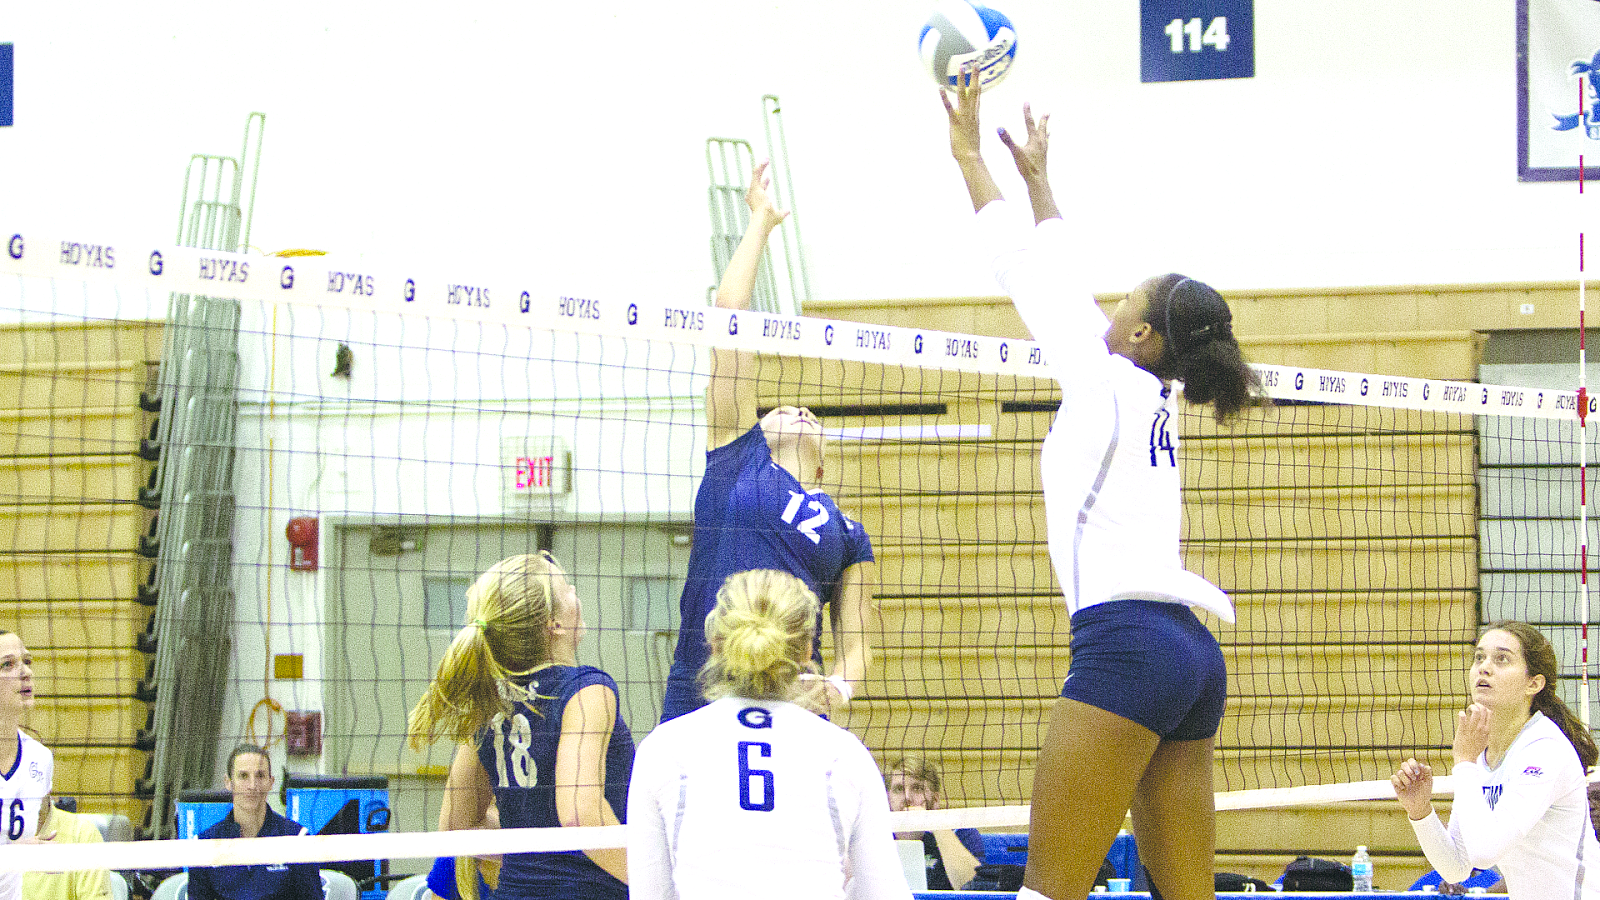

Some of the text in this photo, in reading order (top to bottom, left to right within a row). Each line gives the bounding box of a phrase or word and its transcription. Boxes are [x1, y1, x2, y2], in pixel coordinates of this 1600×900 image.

[1165, 16, 1230, 53] 114
[8, 233, 24, 260] G
[60, 241, 115, 269] HOYAS
[149, 250, 163, 276] G
[199, 257, 249, 283] HOYAS
[280, 264, 294, 290] G
[404, 278, 415, 302] G
[447, 284, 490, 308] HOYAS
[520, 290, 530, 314] G
[558, 296, 600, 320] HOYAS
[627, 303, 638, 326] G
[728, 313, 738, 336] G
[763, 318, 800, 341] HOYAS
[825, 324, 834, 346] G
[857, 329, 891, 350] HOYAS
[914, 334, 923, 354] G
[946, 338, 979, 359] HOYAS
[1000, 342, 1008, 363] G
[1295, 372, 1304, 391] G
[1360, 378, 1369, 396] G
[1423, 383, 1430, 401] G
[1481, 387, 1488, 405] G
[1589, 396, 1597, 413] G
[1149, 407, 1176, 468] 14
[516, 456, 553, 489] EXIT
[781, 489, 830, 545] 12
[737, 706, 773, 729] G
[491, 713, 538, 789] 18
[737, 741, 775, 812] 6
